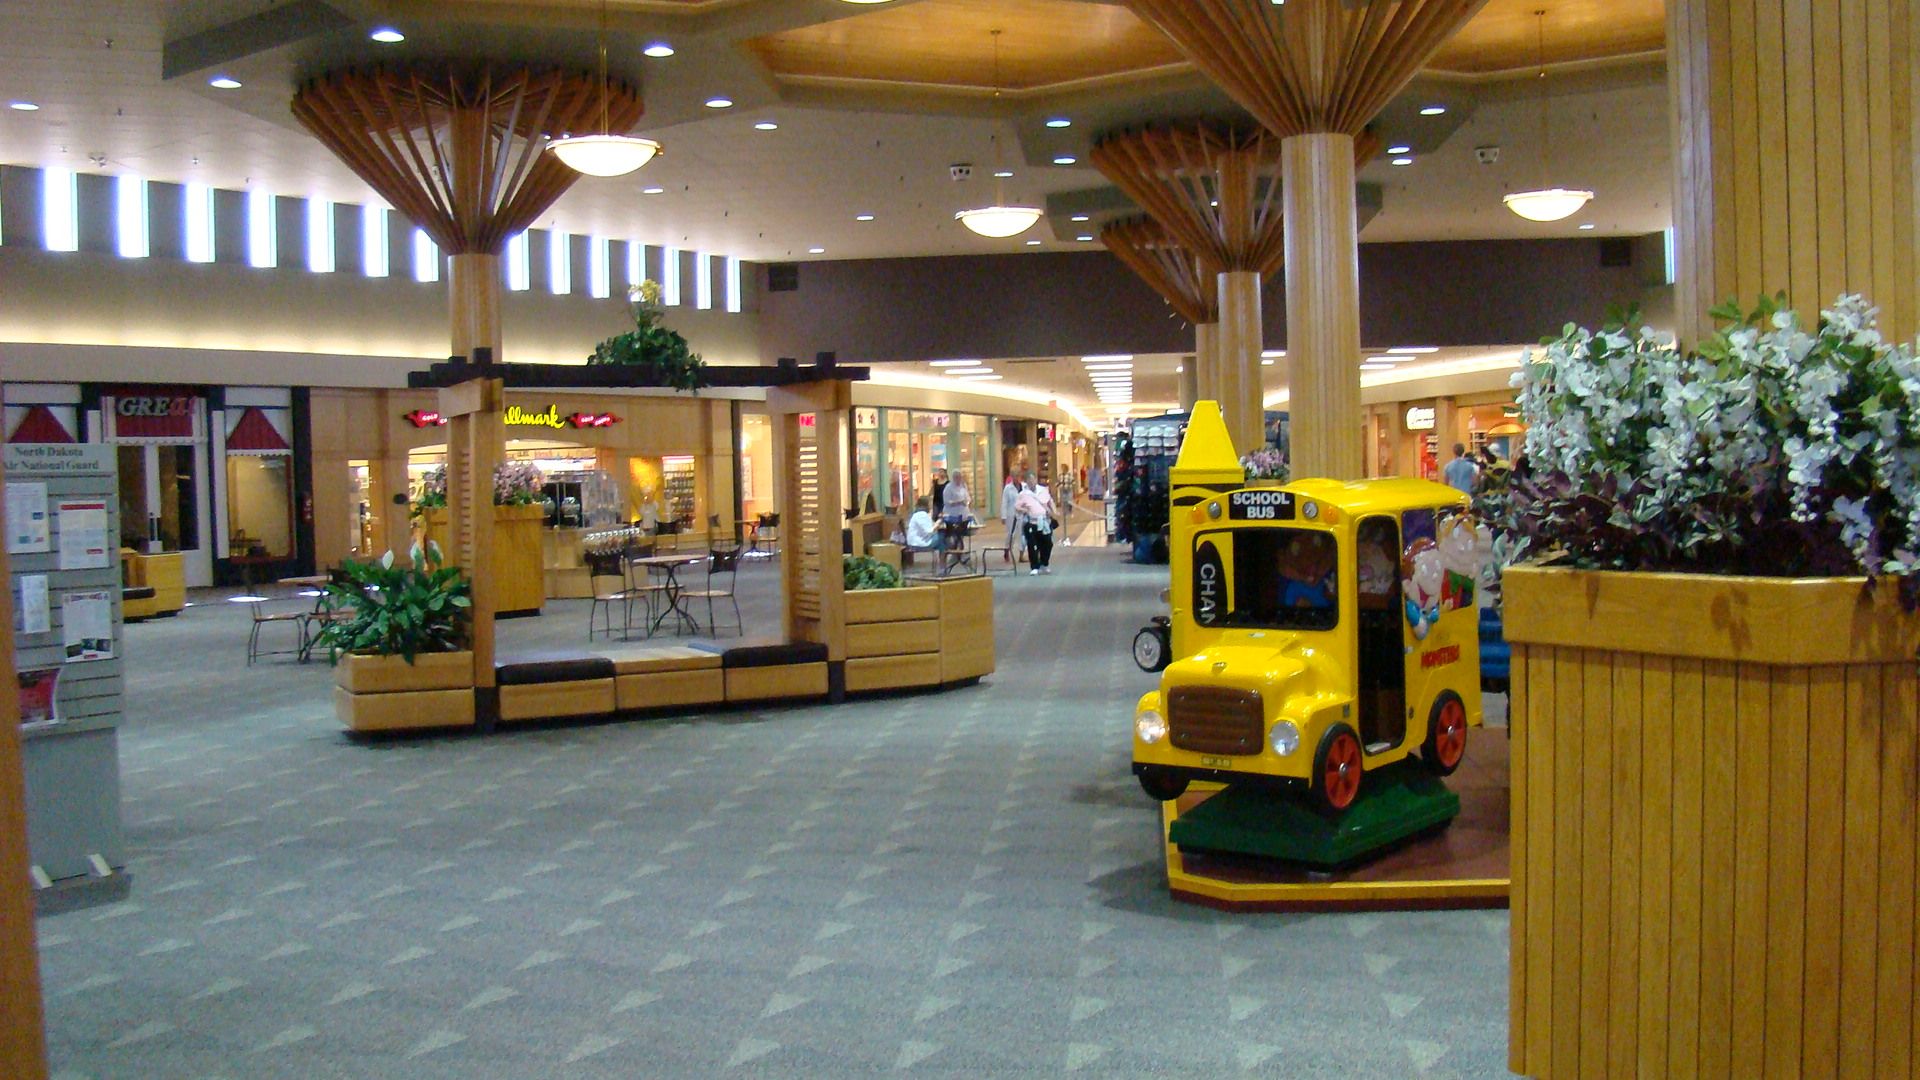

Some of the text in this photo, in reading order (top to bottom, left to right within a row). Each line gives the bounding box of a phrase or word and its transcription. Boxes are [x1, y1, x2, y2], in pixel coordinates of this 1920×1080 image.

[15, 446, 84, 457] North Dakota
[21, 460, 65, 470] National
[66, 460, 99, 470] Guard
[1232, 492, 1290, 505] SCHOOL
[1246, 505, 1275, 519] BUS
